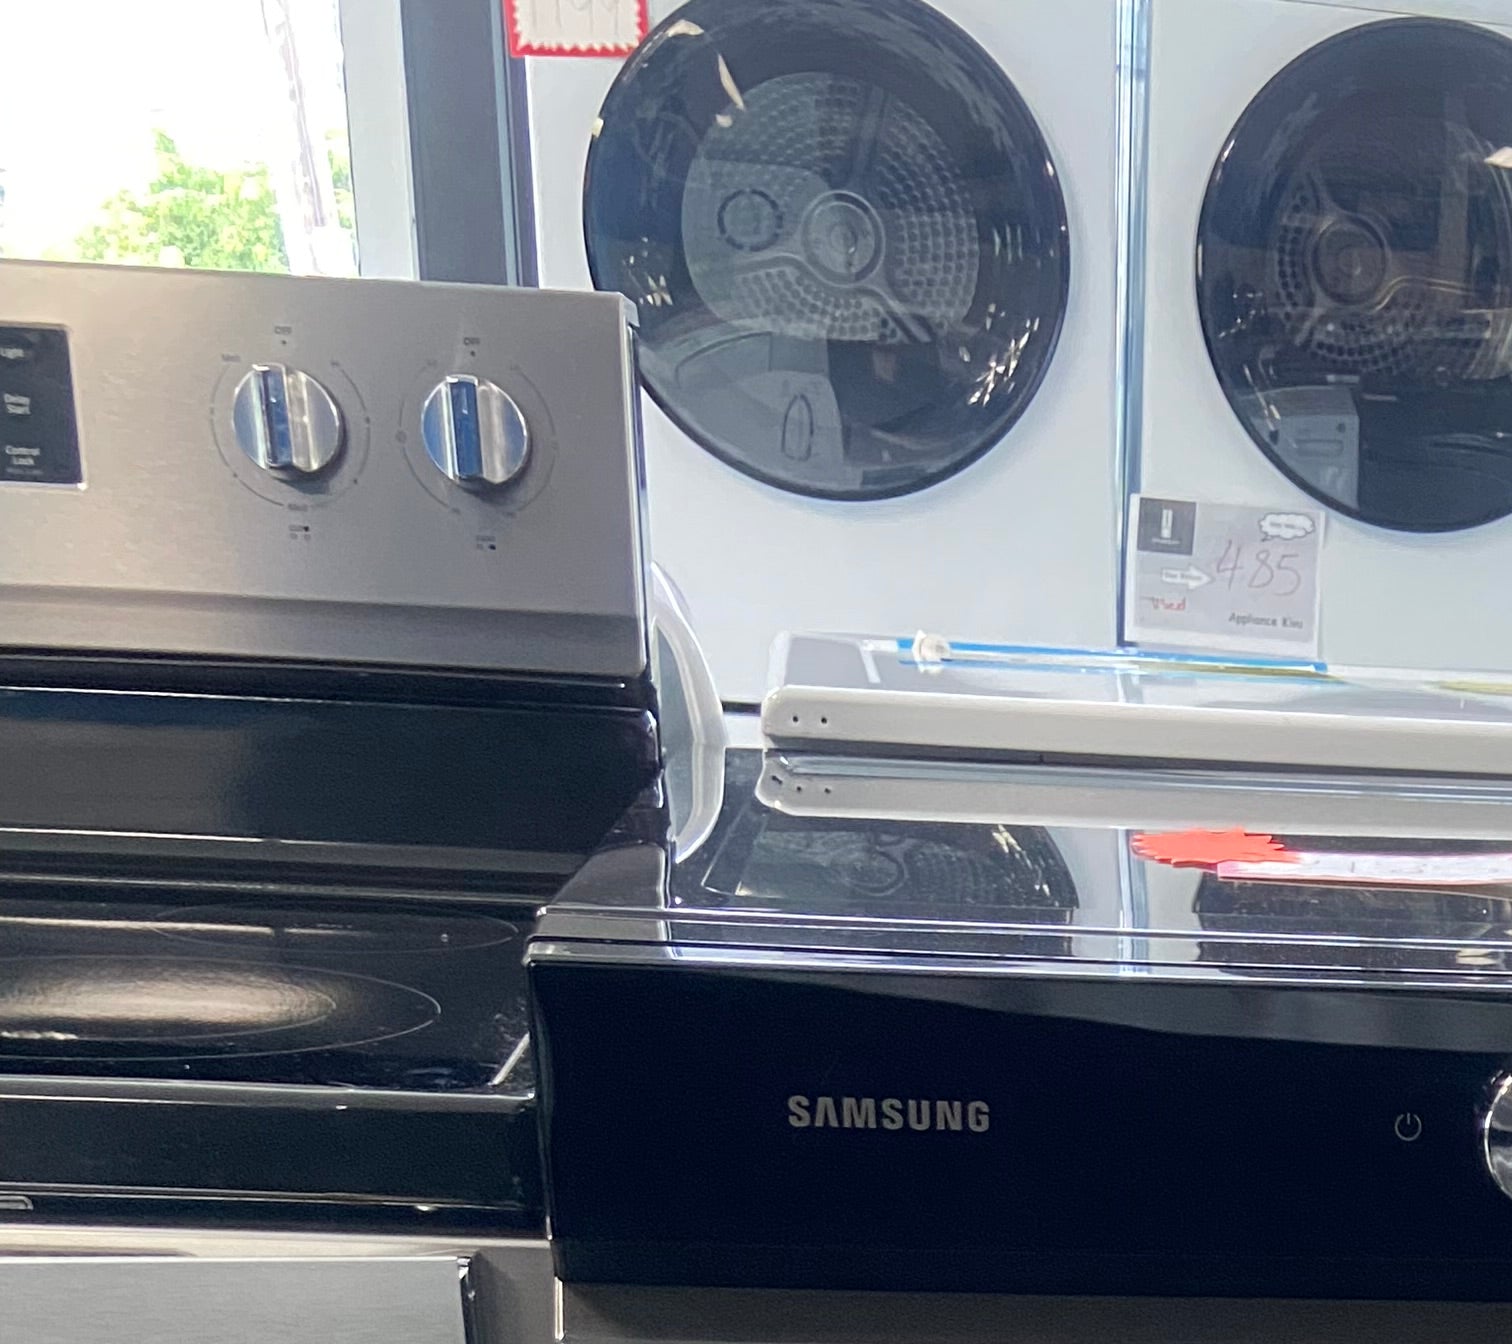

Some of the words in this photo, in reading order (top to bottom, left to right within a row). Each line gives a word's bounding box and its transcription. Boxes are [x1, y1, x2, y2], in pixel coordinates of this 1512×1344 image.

[1216, 539, 1302, 597] 485
[1228, 611, 1278, 627] Appliance
[788, 1094, 990, 1133] SAMSUNG
